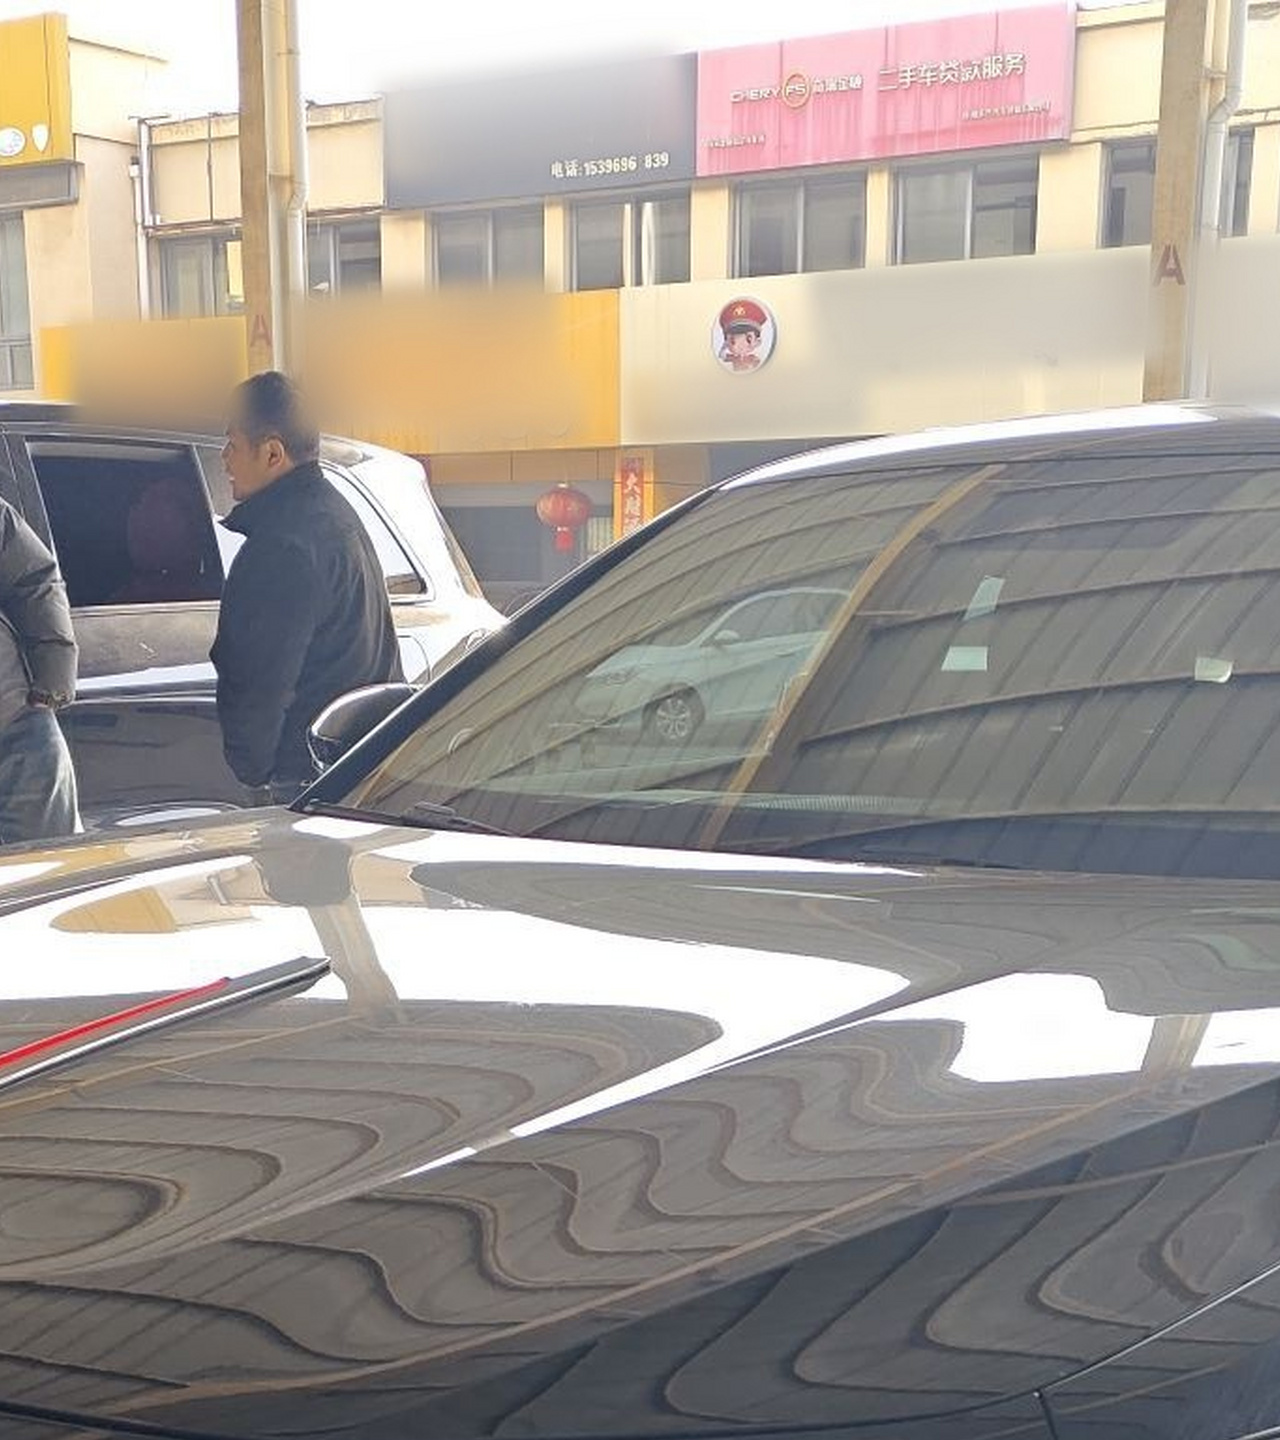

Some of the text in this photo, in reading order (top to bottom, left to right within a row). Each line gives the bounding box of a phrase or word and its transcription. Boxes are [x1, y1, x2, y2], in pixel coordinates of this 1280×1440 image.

[878, 52, 1025, 92] 二手车贷款服务
